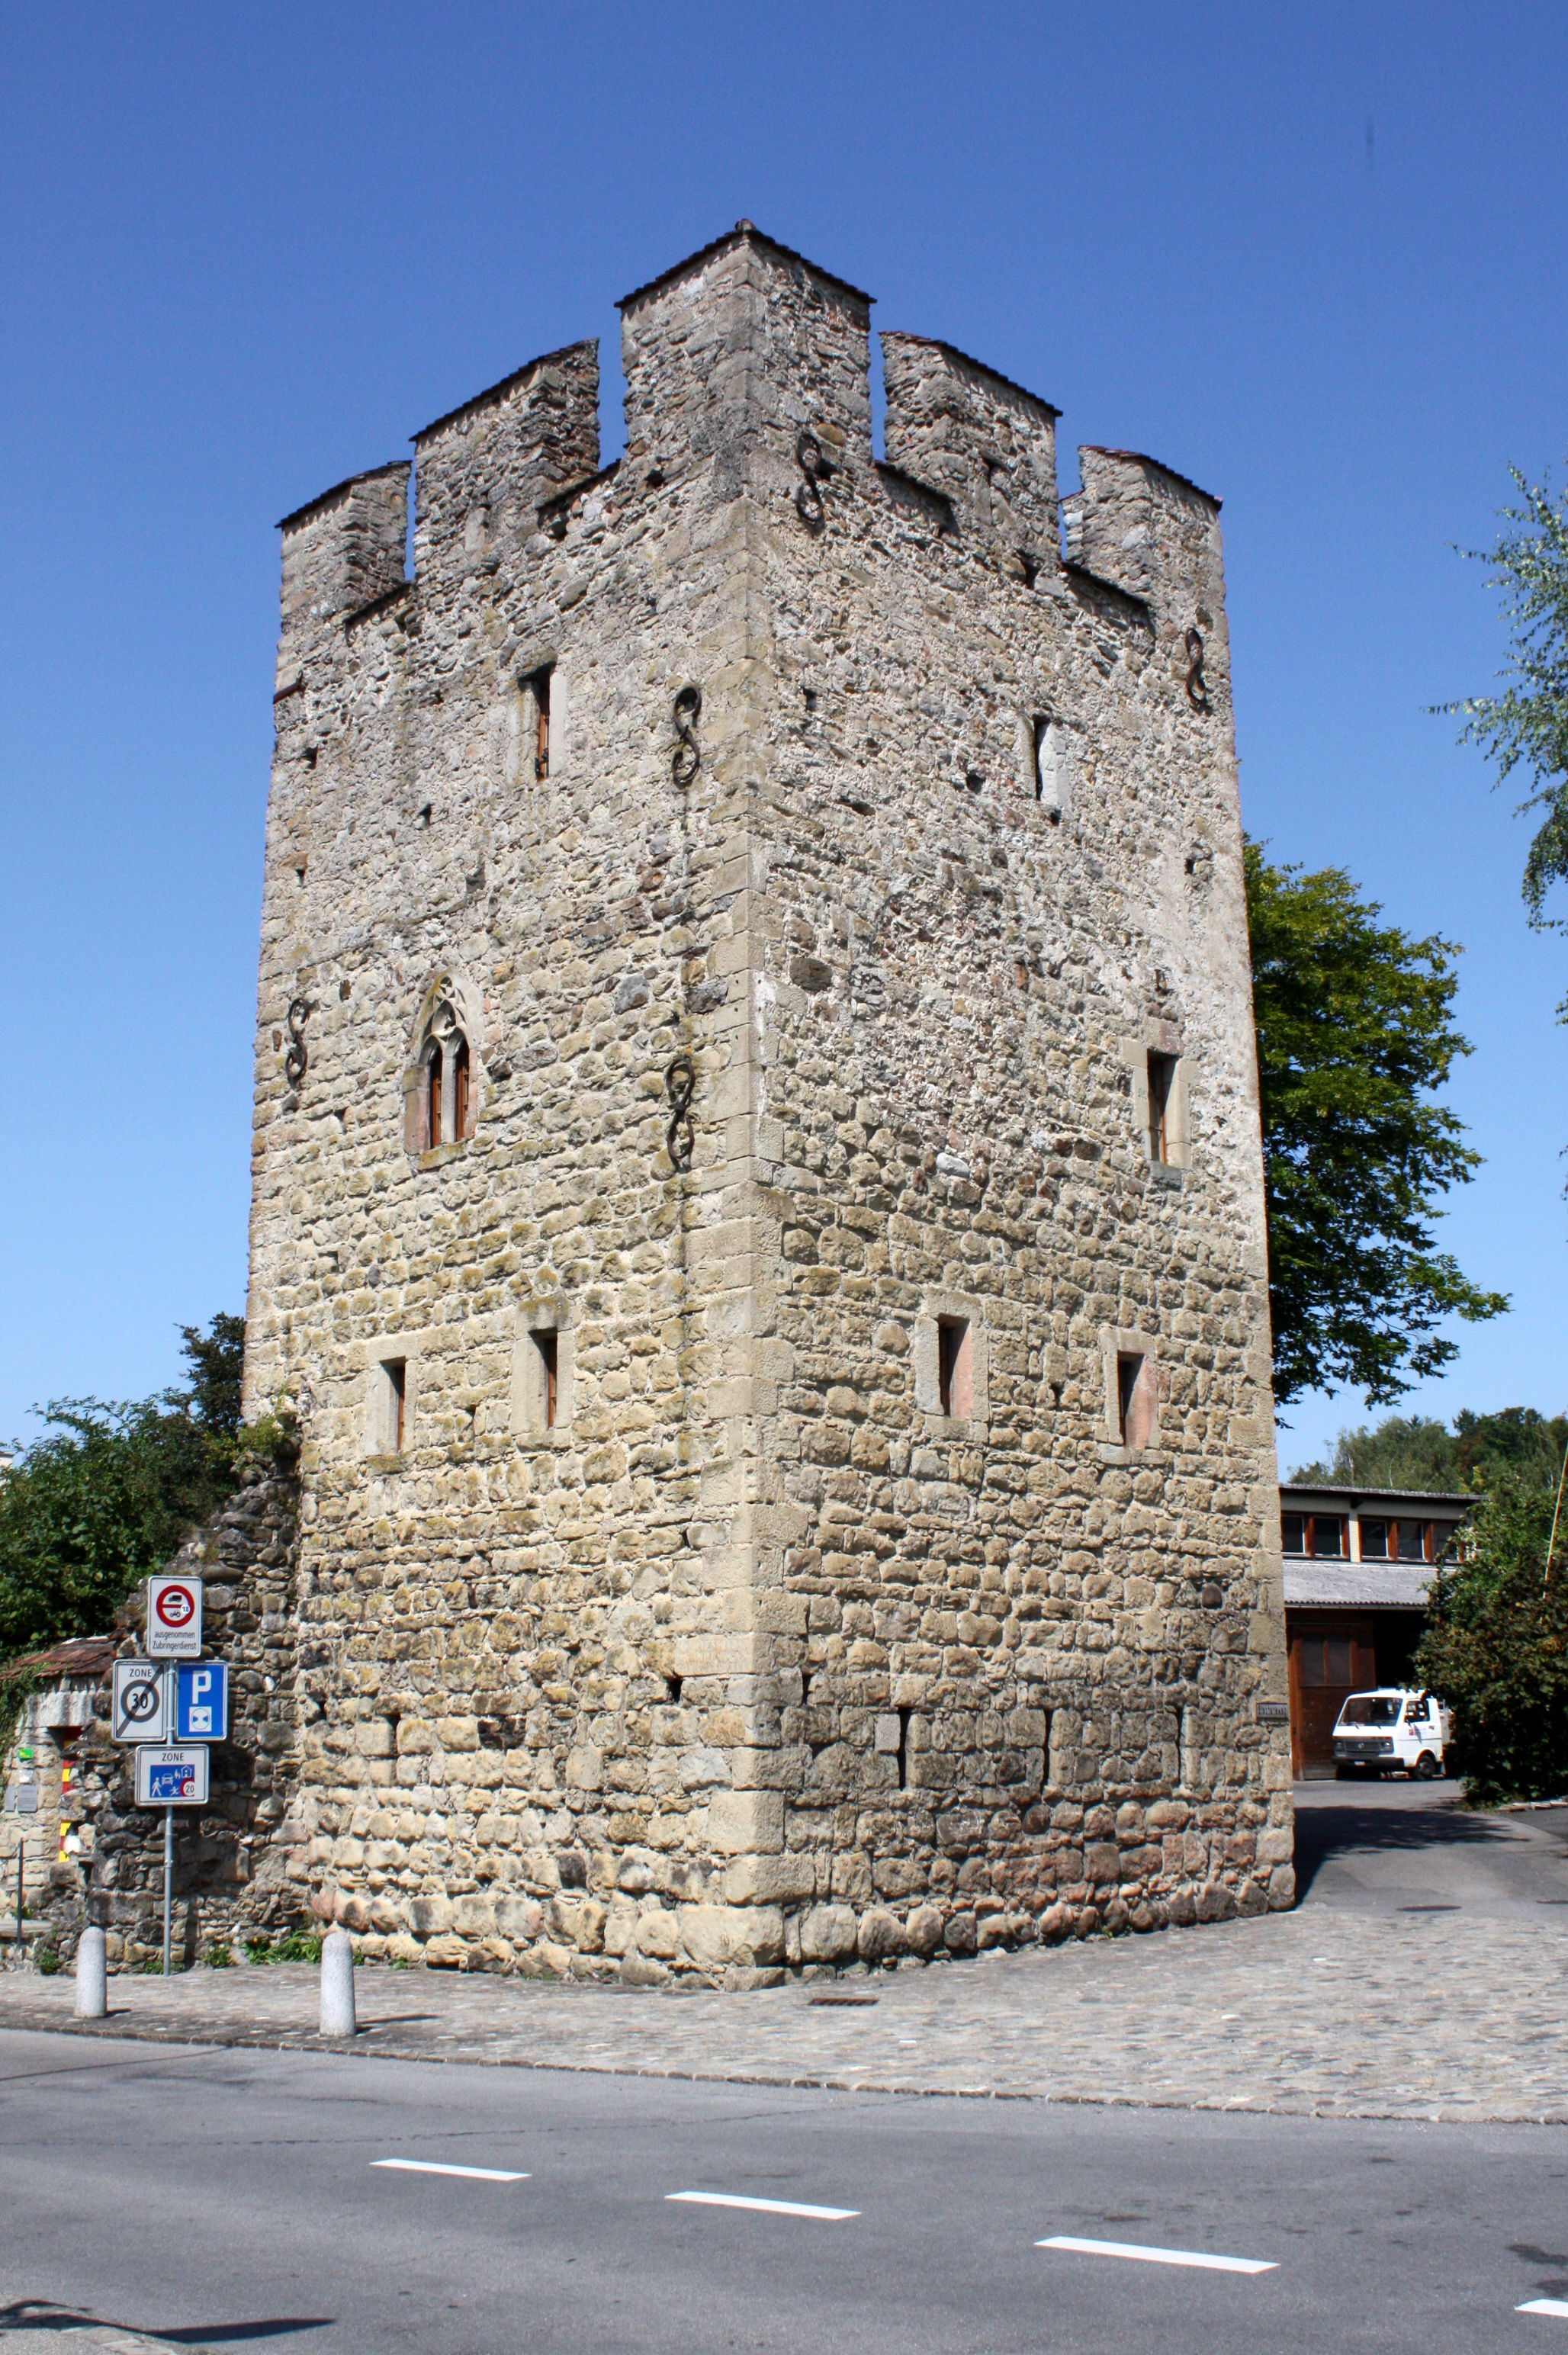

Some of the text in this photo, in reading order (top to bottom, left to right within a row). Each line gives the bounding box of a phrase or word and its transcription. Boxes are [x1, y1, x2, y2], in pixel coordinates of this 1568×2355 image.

[155, 1631, 195, 1640] ausgenommen
[153, 1641, 197, 1652] Zubringerdienst
[130, 1669, 152, 1677] ZONE
[192, 1670, 212, 1704] P
[132, 1693, 149, 1709] 30
[162, 1753, 185, 1762] ZONE
[186, 1785, 194, 1793] 20
